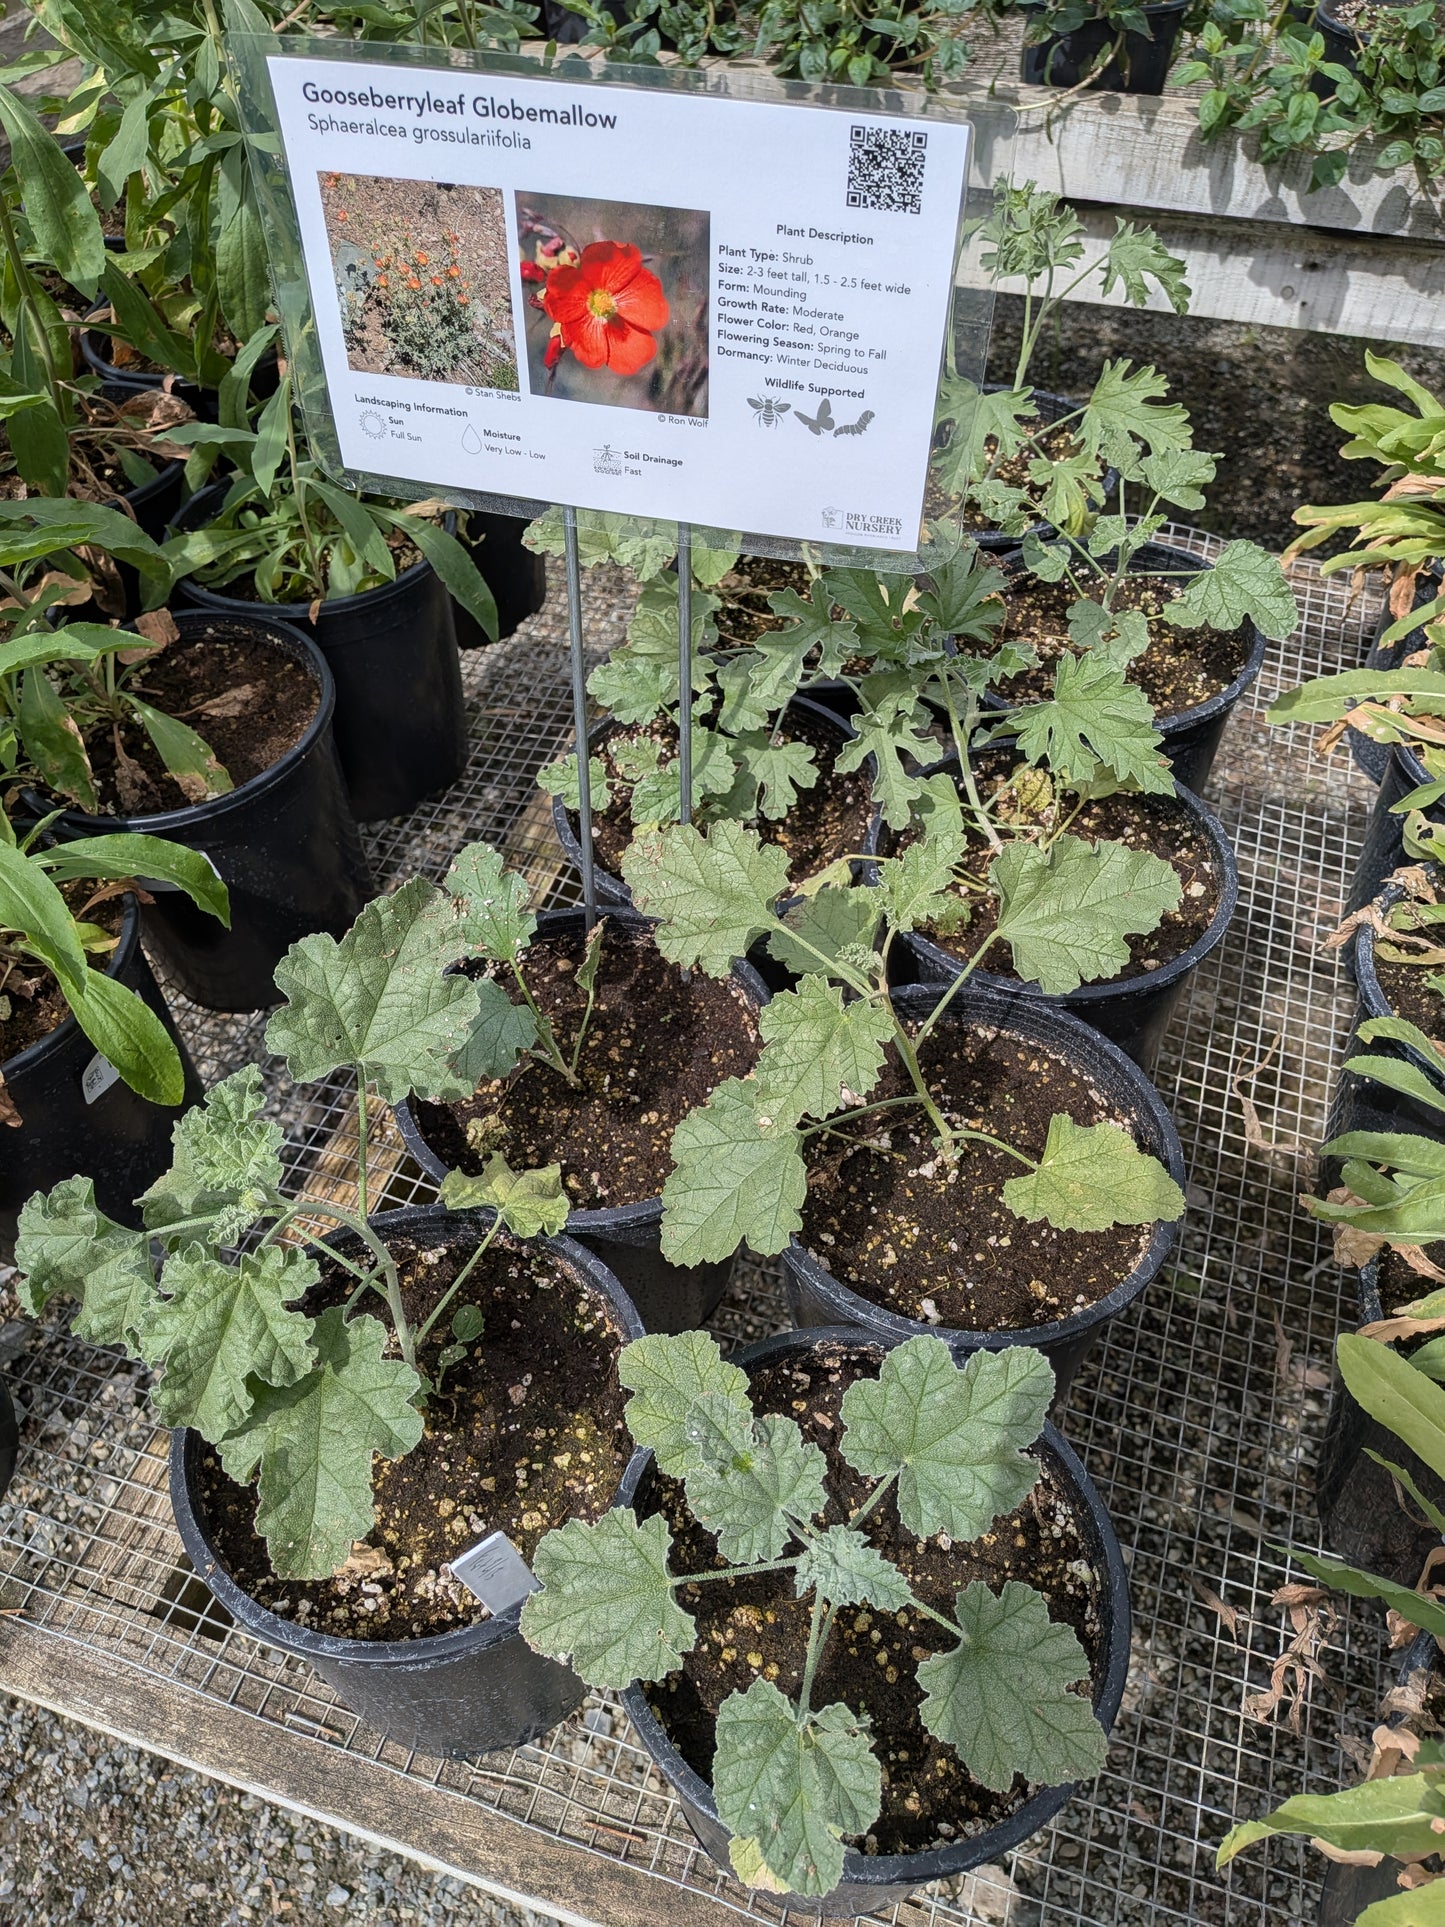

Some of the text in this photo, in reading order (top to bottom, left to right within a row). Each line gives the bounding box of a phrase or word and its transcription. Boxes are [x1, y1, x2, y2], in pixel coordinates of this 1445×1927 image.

[302, 82, 617, 129] Gooseberryleaf Globemallow
[308, 114, 531, 150] Sphaeralcea grossulariifolia
[776, 224, 874, 245] Plant Description
[718, 245, 814, 265] Plant Type: Shrub
[718, 263, 743, 275] Size:
[746, 266, 764, 278] 2-3
[767, 268, 788, 281] feet
[791, 271, 810, 284] tall,
[814, 274, 830, 285] 1.5
[840, 277, 857, 288] 2.5
[860, 279, 882, 292] feet
[885, 282, 911, 295] wide
[718, 280, 807, 302] Form: Mounding
[717, 297, 845, 321] Growth Rate: Moderate
[717, 313, 860, 341] Flower Color: Red, Orange
[717, 330, 887, 360] Flowering Season: Spring to Fall
[717, 346, 869, 375] Dormancy: Winter Deciduous
[475, 388, 494, 399] Stan
[496, 391, 522, 402] Shebs
[765, 377, 865, 399] Wildlife Supported
[354, 393, 468, 418] Landscaping Information
[389, 416, 404, 426] Sun
[668, 416, 685, 425] Ron
[688, 418, 708, 428] Wolf
[390, 430, 422, 442] Full Sun
[483, 429, 521, 442] Moisture
[484, 444, 503, 455] Very
[505, 446, 522, 456] Low
[529, 450, 546, 460] Low
[623, 451, 683, 467] Soil Drainage
[624, 466, 642, 476] Fast
[846, 512, 902, 526] DRY CREEK
[846, 521, 902, 535] NURSERY
